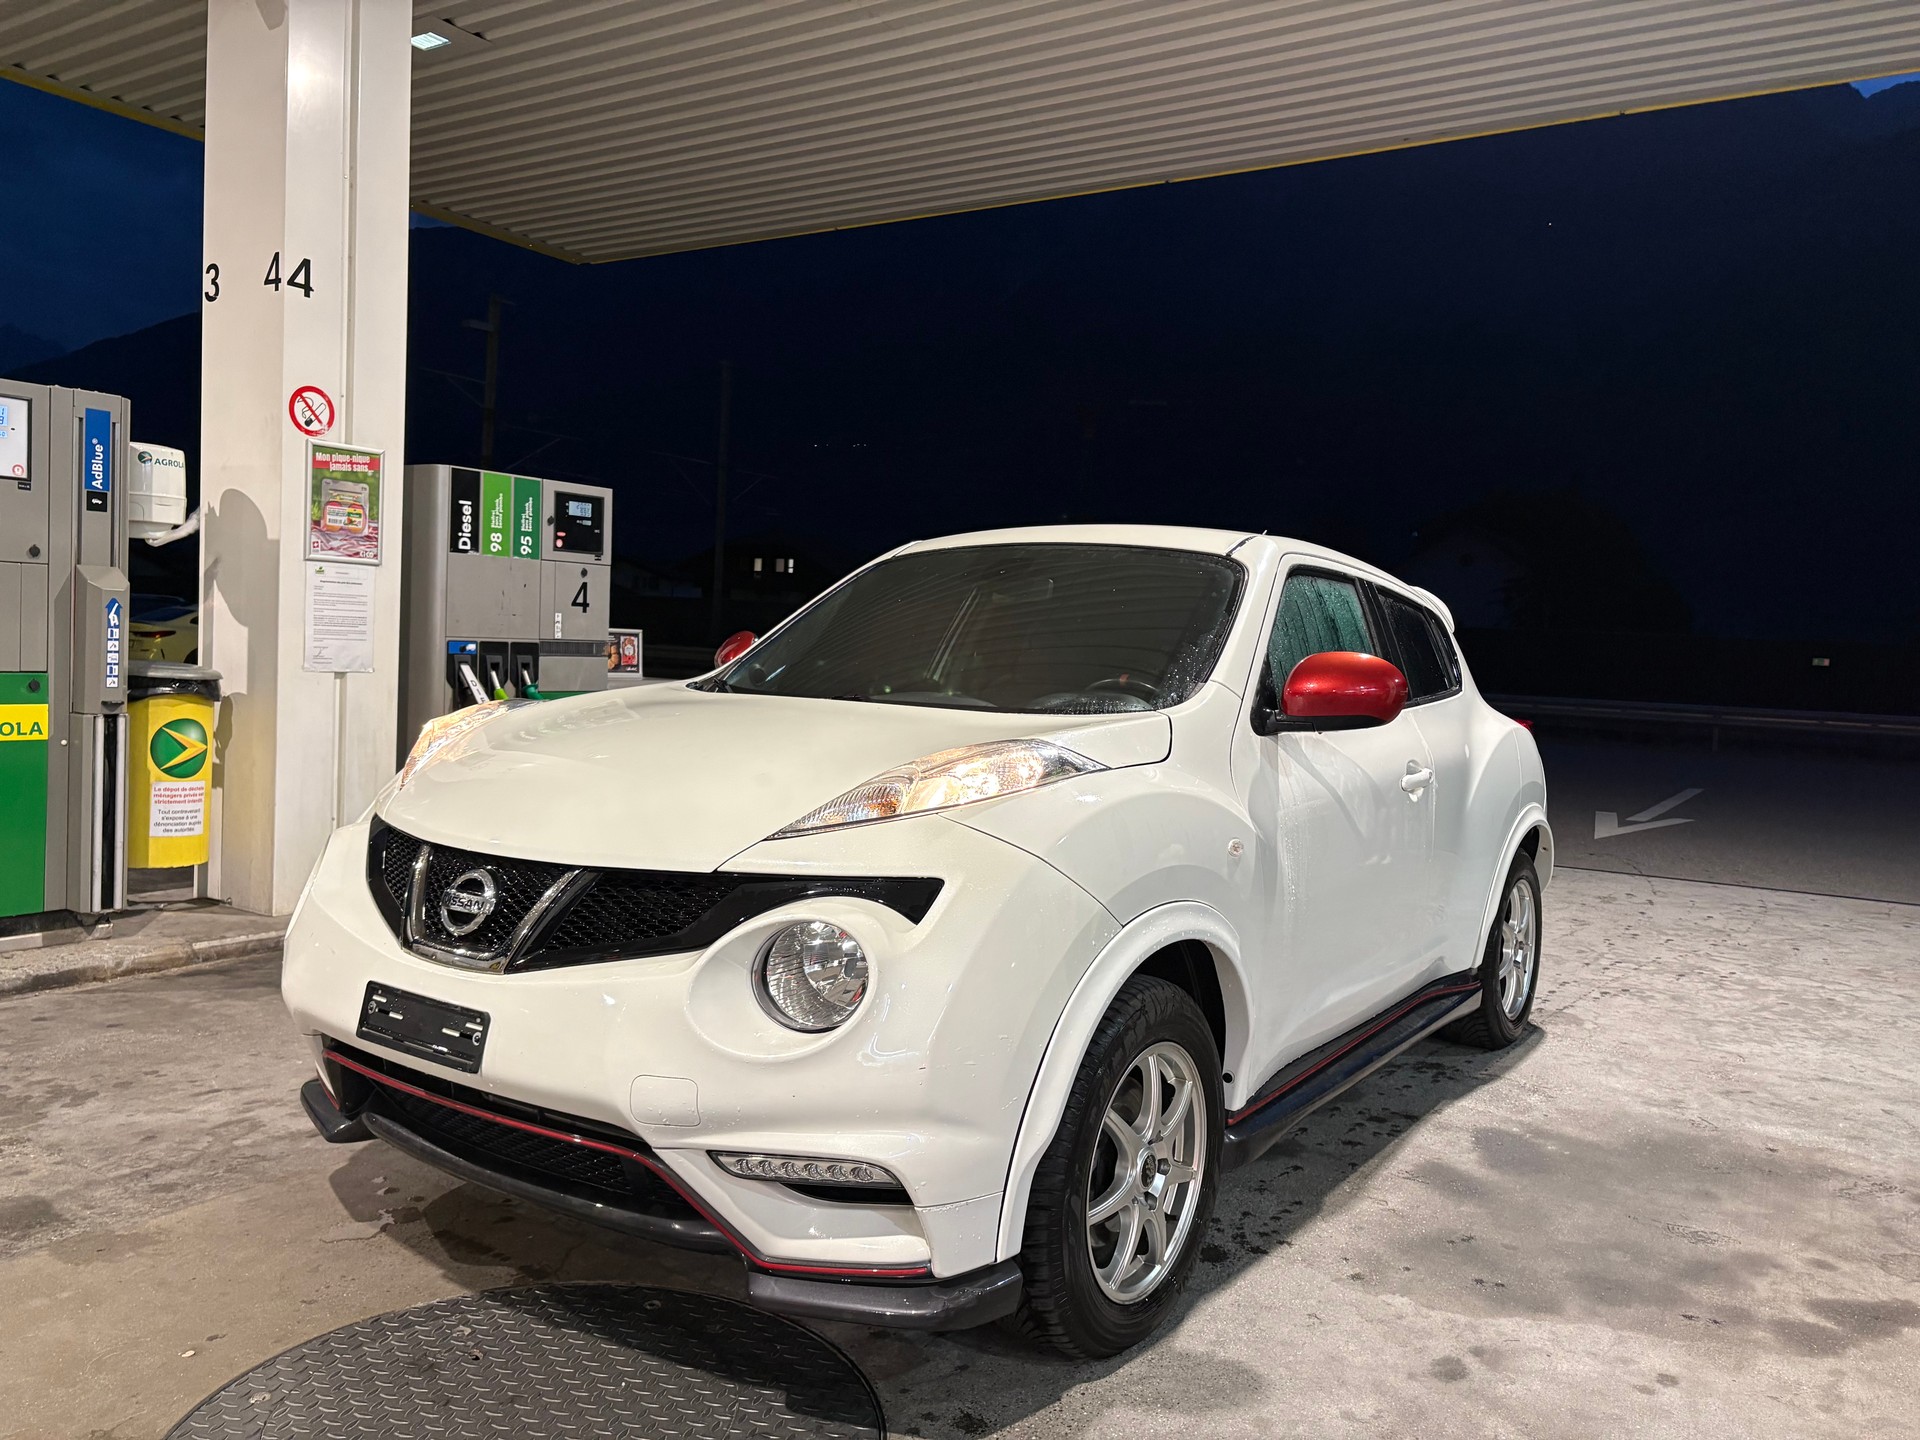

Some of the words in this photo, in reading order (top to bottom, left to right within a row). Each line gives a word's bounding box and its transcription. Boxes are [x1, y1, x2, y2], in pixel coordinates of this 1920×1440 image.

[264, 252, 282, 292] 4
[287, 258, 314, 298] 4
[205, 263, 220, 302] 3
[316, 452, 330, 462] Mon
[332, 453, 370, 464] pique-nique
[330, 461, 351, 472] jamais
[458, 500, 472, 550] Diesel
[490, 533, 502, 552] 98
[520, 536, 532, 555] 95
[571, 582, 590, 613] 4
[0, 721, 43, 736] OLA
[153, 792, 182, 800] ménagers
